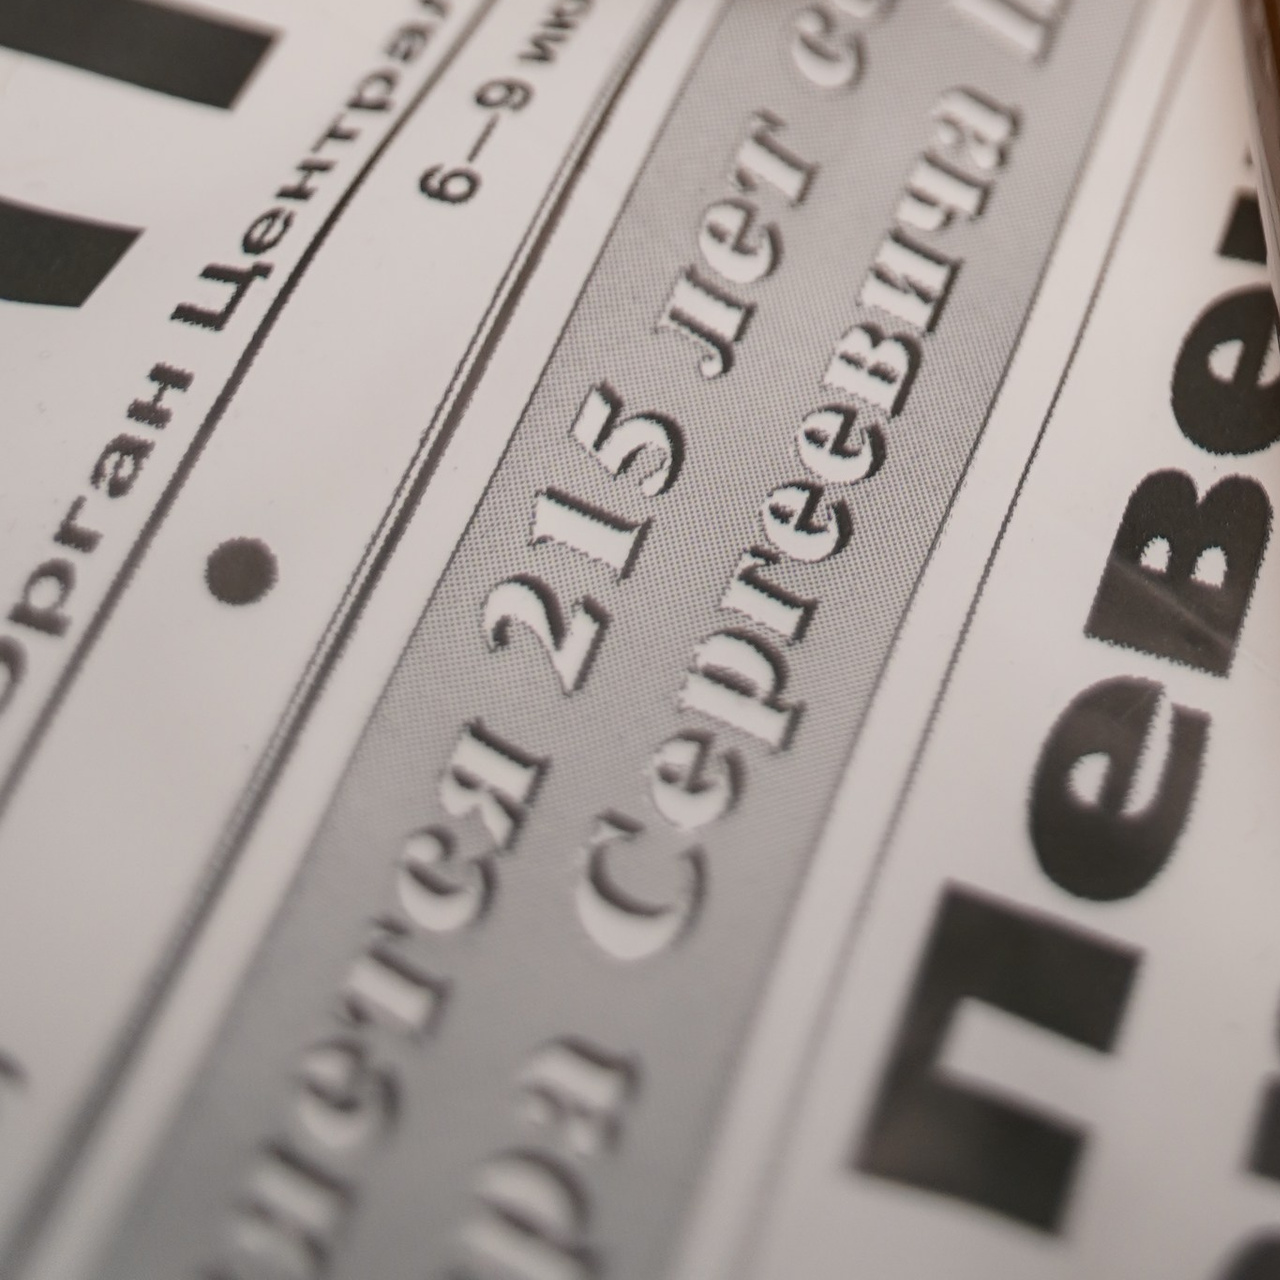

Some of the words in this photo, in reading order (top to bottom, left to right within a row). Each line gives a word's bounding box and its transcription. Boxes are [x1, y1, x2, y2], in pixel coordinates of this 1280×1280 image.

[480, 380, 690, 699] 215
[650, 108, 824, 383] лет
[574, 80, 1024, 963] Сергеевича
